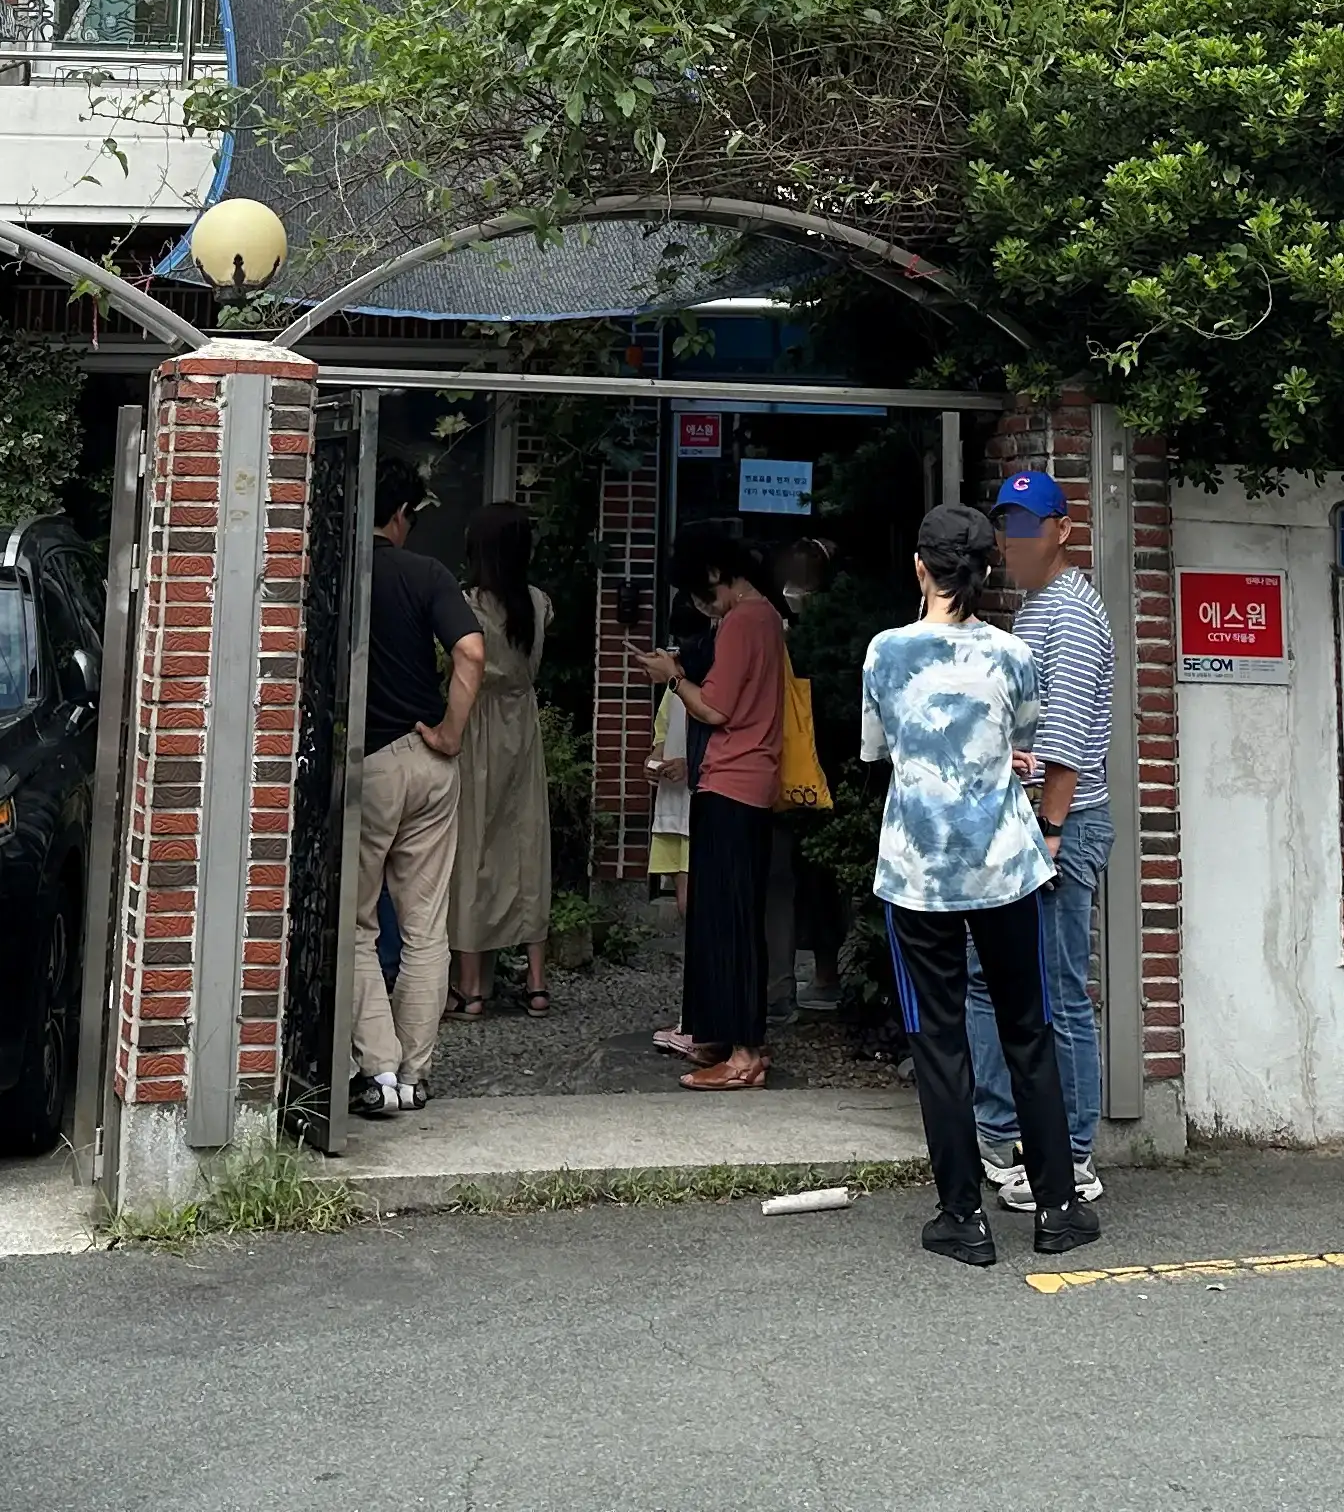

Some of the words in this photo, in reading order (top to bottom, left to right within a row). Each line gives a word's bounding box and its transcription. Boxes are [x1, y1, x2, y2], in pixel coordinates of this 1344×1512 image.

[1013, 477, 1031, 491] C
[1199, 602, 1267, 630] 에스원
[1207, 632, 1232, 642] CCTV
[1183, 658, 1234, 672] SECOM
